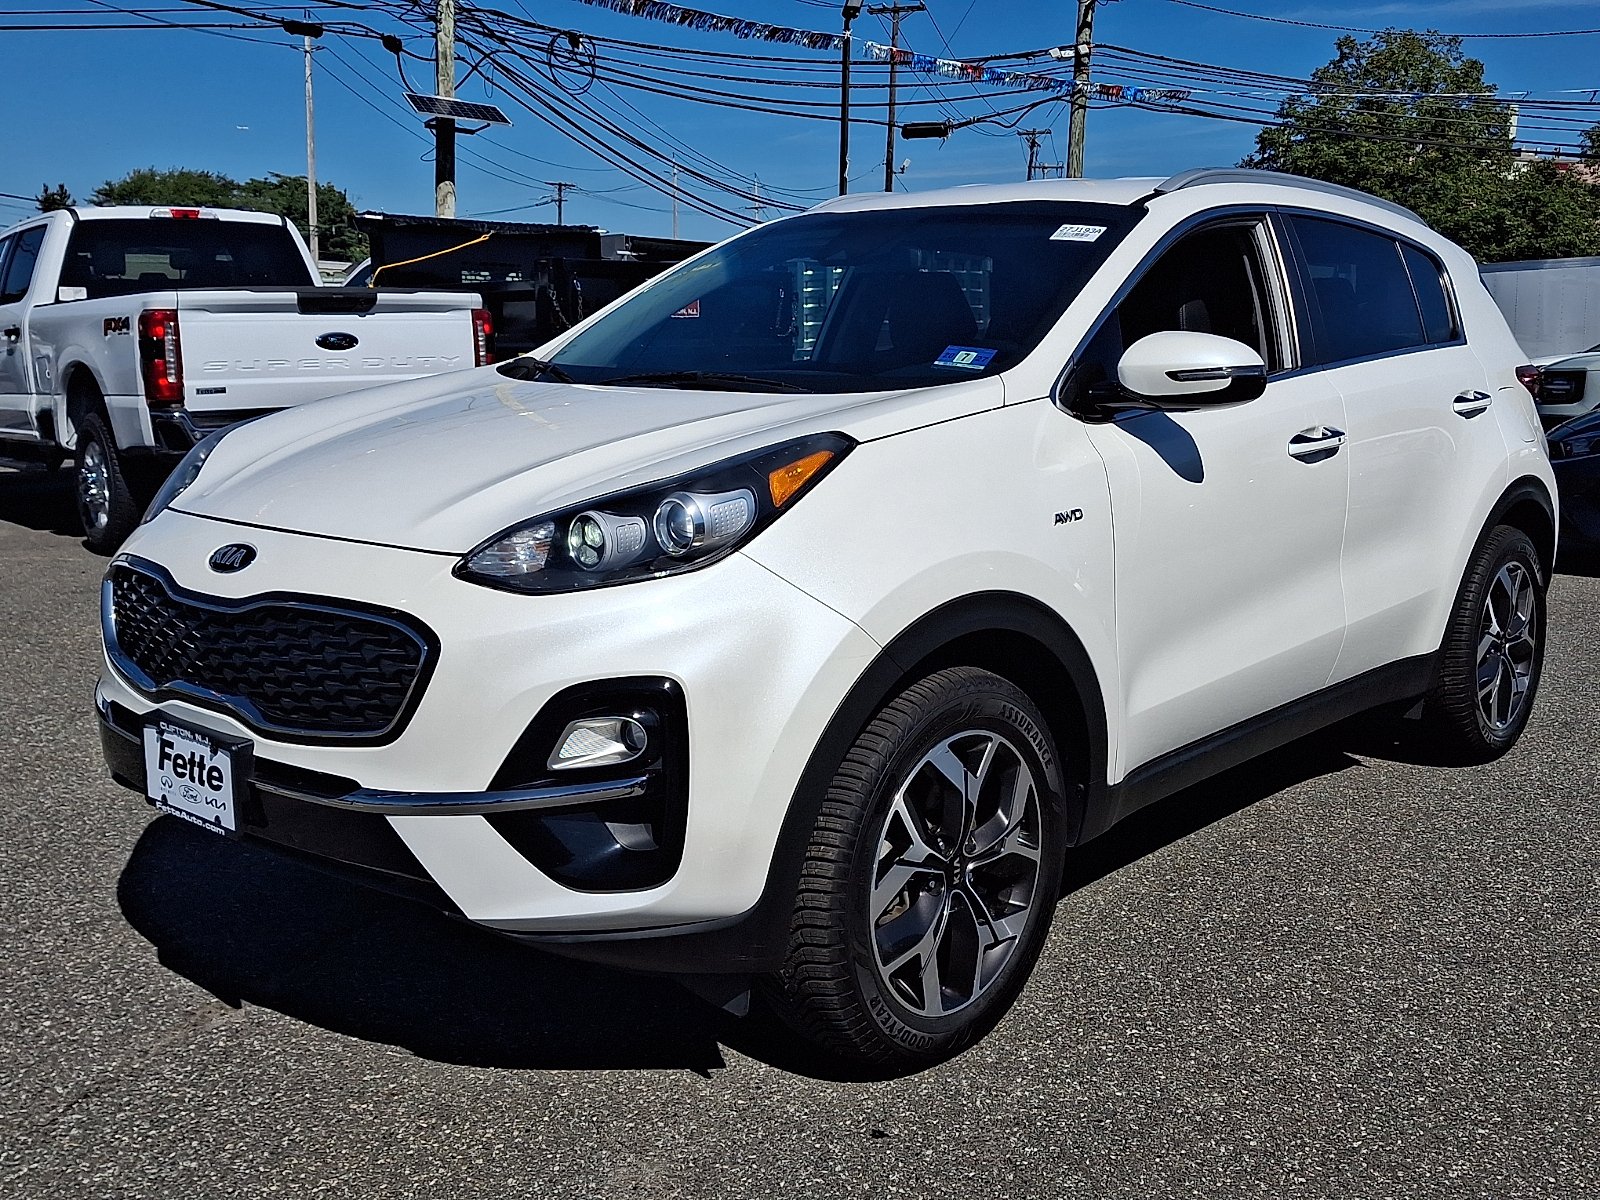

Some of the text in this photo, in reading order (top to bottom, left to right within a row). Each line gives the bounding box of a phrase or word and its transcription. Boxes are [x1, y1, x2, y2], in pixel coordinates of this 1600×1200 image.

[1060, 226, 1102, 234] 27J193A
[103, 317, 130, 336] FX4
[203, 355, 460, 372] SUPER DUTY
[961, 352, 970, 361] 7
[1053, 508, 1083, 526] AWD
[211, 546, 247, 567] KIA
[160, 721, 194, 740] CLIFTON,
[999, 704, 1053, 769] ASSURANCE
[158, 738, 224, 792] Fette
[156, 801, 226, 836] FetteAuto.com
